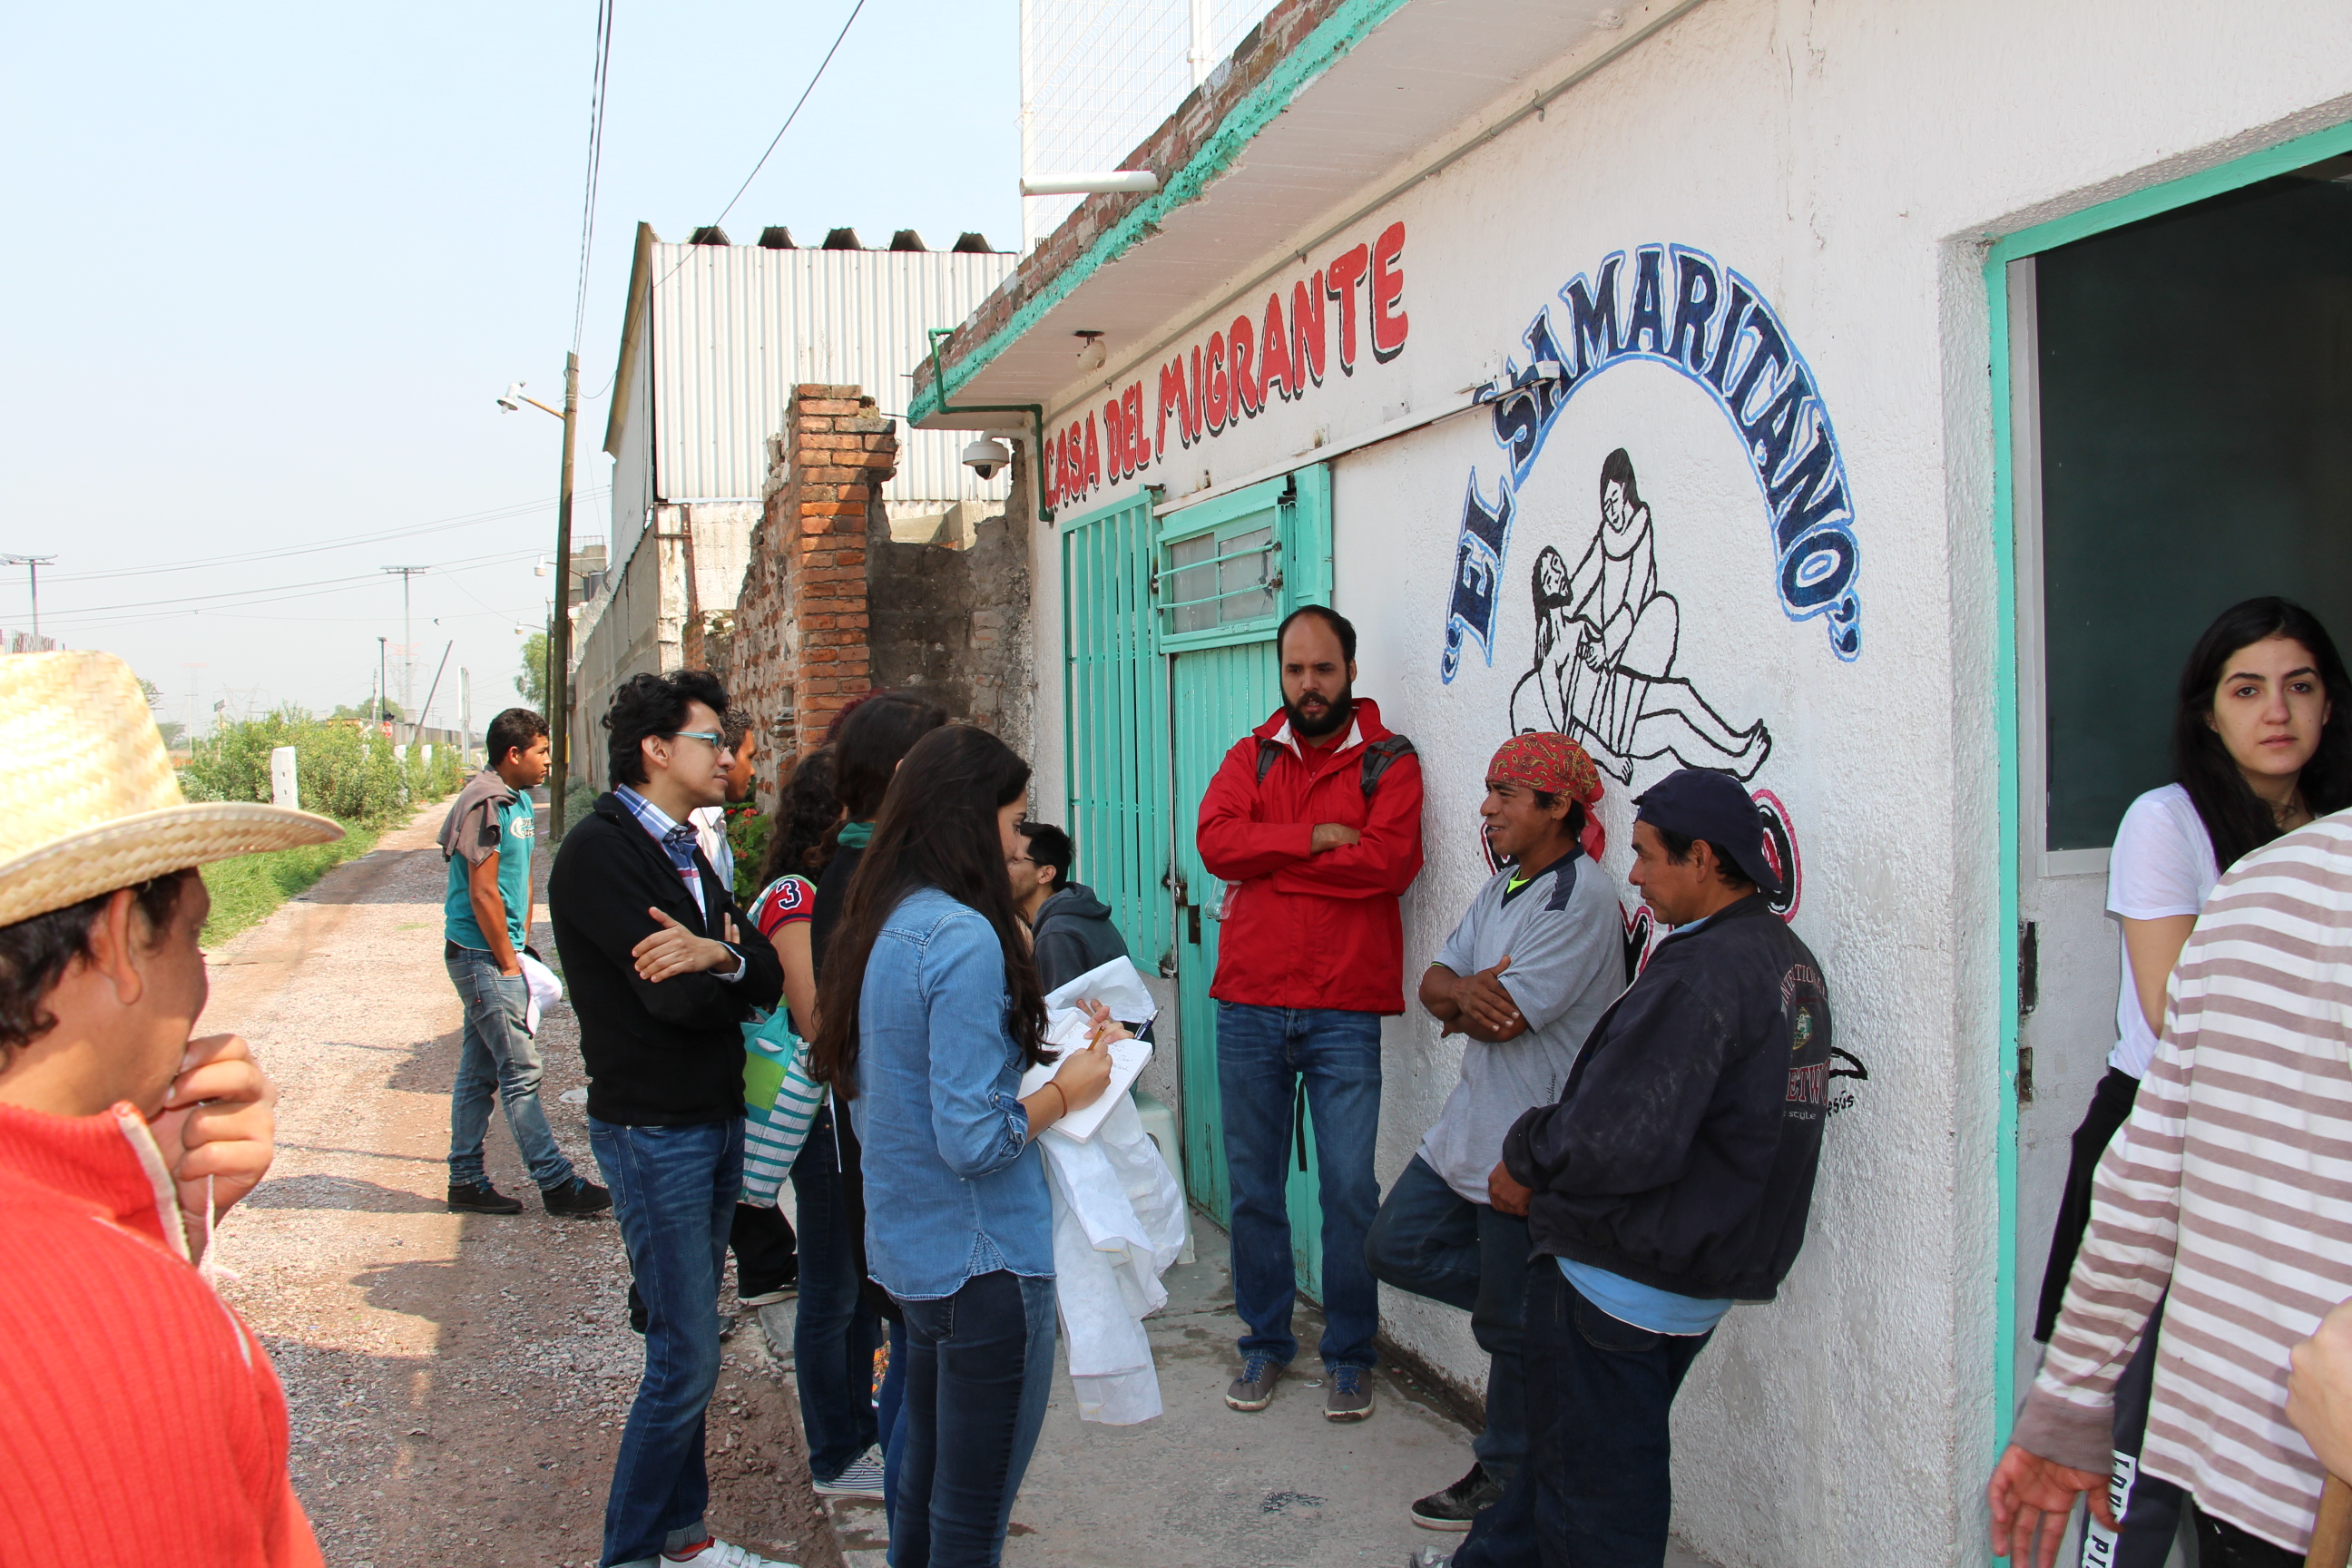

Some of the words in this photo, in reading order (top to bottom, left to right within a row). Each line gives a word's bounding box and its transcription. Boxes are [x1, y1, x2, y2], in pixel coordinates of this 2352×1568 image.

[1044, 410, 1100, 512] CASA
[1103, 379, 1152, 485] DEL
[1155, 220, 1408, 465] MIGRANTE
[775, 878, 803, 910] 3
[1827, 1090, 1854, 1117] esús
[2108, 1457, 2131, 1521] LOV
[2085, 1534, 2110, 1568] PI
